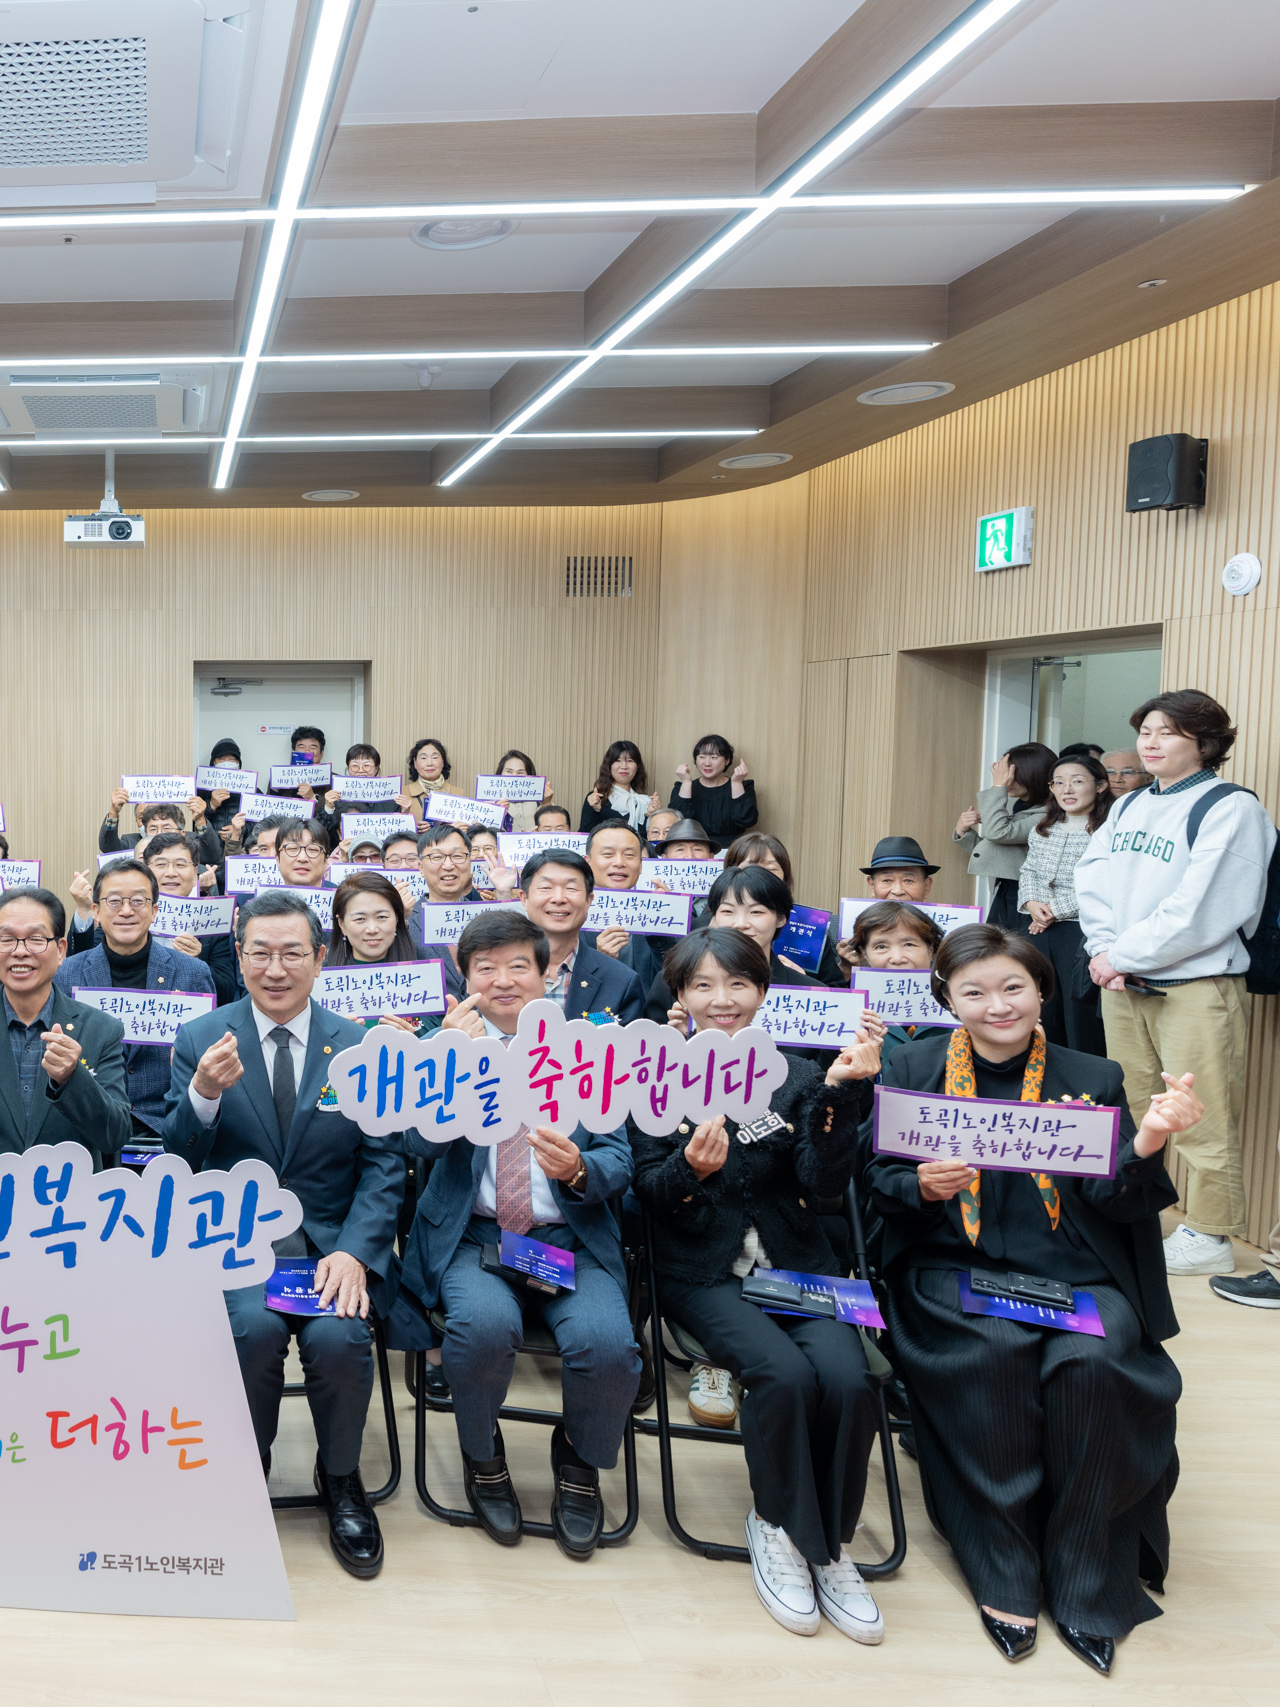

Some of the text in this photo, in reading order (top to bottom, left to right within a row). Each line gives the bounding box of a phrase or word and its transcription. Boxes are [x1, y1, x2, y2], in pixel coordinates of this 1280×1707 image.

[136, 779, 185, 789] 도곡1노인복지관
[345, 780, 391, 790] 도곡1노인복지관
[489, 779, 535, 789] 도곡1노인복지관
[254, 798, 303, 811] 도곡1노인복지관
[443, 798, 494, 815] 도곡1노인복지관
[356, 817, 405, 827] 도곡1노인복지관
[1111, 829, 1175, 863] CHICAGO
[509, 853, 530, 864] 개관
[244, 862, 280, 875] 도곡1노인
[654, 864, 724, 877] 도곡1노인복지관
[4, 876, 36, 886] 합니다
[679, 877, 712, 891] 축하합
[157, 900, 219, 917] 곡1노인복지관
[590, 896, 670, 912] 곡1노인복지관
[445, 908, 485, 922] 도곡1노
[589, 911, 684, 927] 관을 축하합니다
[171, 916, 228, 932] 축하합니다
[324, 972, 421, 992] 도곡1노인복지관
[885, 978, 932, 996] 도곡1노인
[99, 997, 191, 1017] 도곡1노인복지관
[360, 990, 440, 1011] 축하합니다
[760, 997, 838, 1016] 인복지관
[869, 999, 913, 1018] 개관을
[130, 1017, 183, 1038] 축하합니
[761, 1016, 855, 1037] 축하합니다
[347, 1019, 769, 1128] 개관을 축하합니다
[736, 1112, 786, 1144] 이도희
[918, 1106, 1077, 1136] 도곡1노인복지관
[897, 1129, 1105, 1163] 개관을 축하합니다
[49, 1396, 209, 1471] 더하는
[101, 1553, 225, 1576] 도곡1노인복지관
